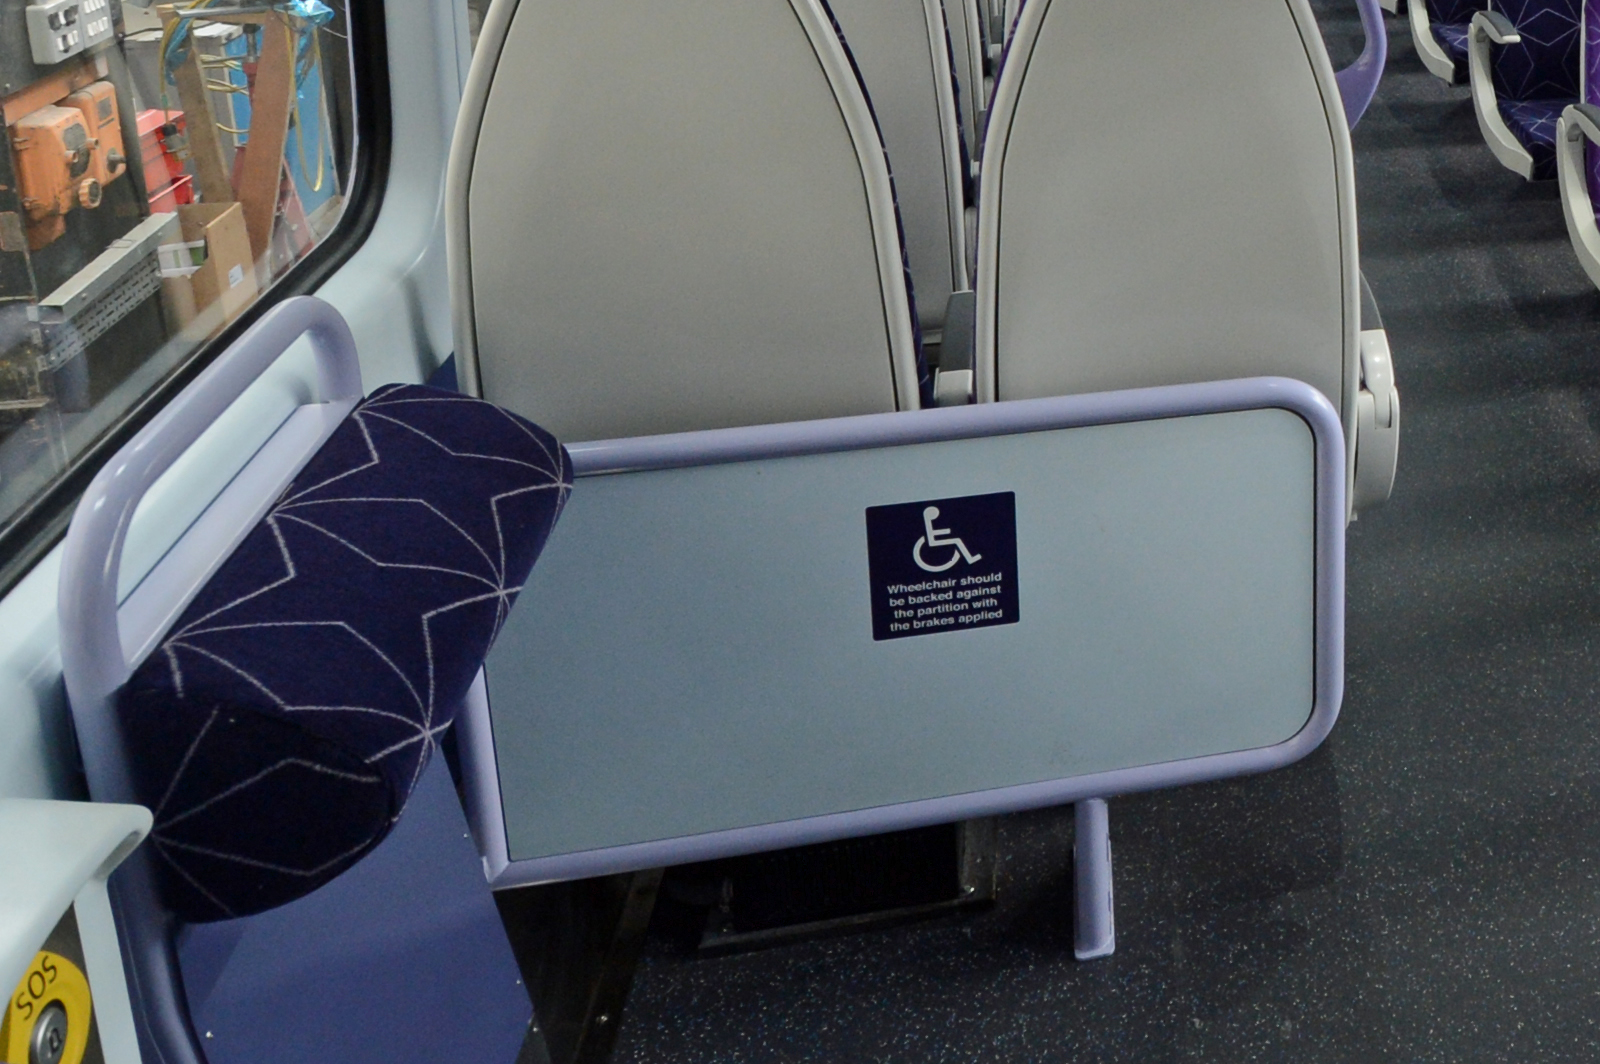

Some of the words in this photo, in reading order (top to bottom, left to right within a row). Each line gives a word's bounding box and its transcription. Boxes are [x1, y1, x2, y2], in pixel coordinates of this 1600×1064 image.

[887, 579, 957, 595] Wheelchair
[960, 572, 1003, 586] should
[889, 597, 905, 607] be
[908, 591, 953, 605] backed
[956, 585, 1002, 601] against
[894, 609, 914, 619] the
[917, 602, 969, 618] partition
[972, 597, 998, 609] with
[890, 622, 910, 632] the
[913, 616, 955, 629] brakes
[958, 609, 1003, 624] applied
[15, 955, 58, 1020] SOS
